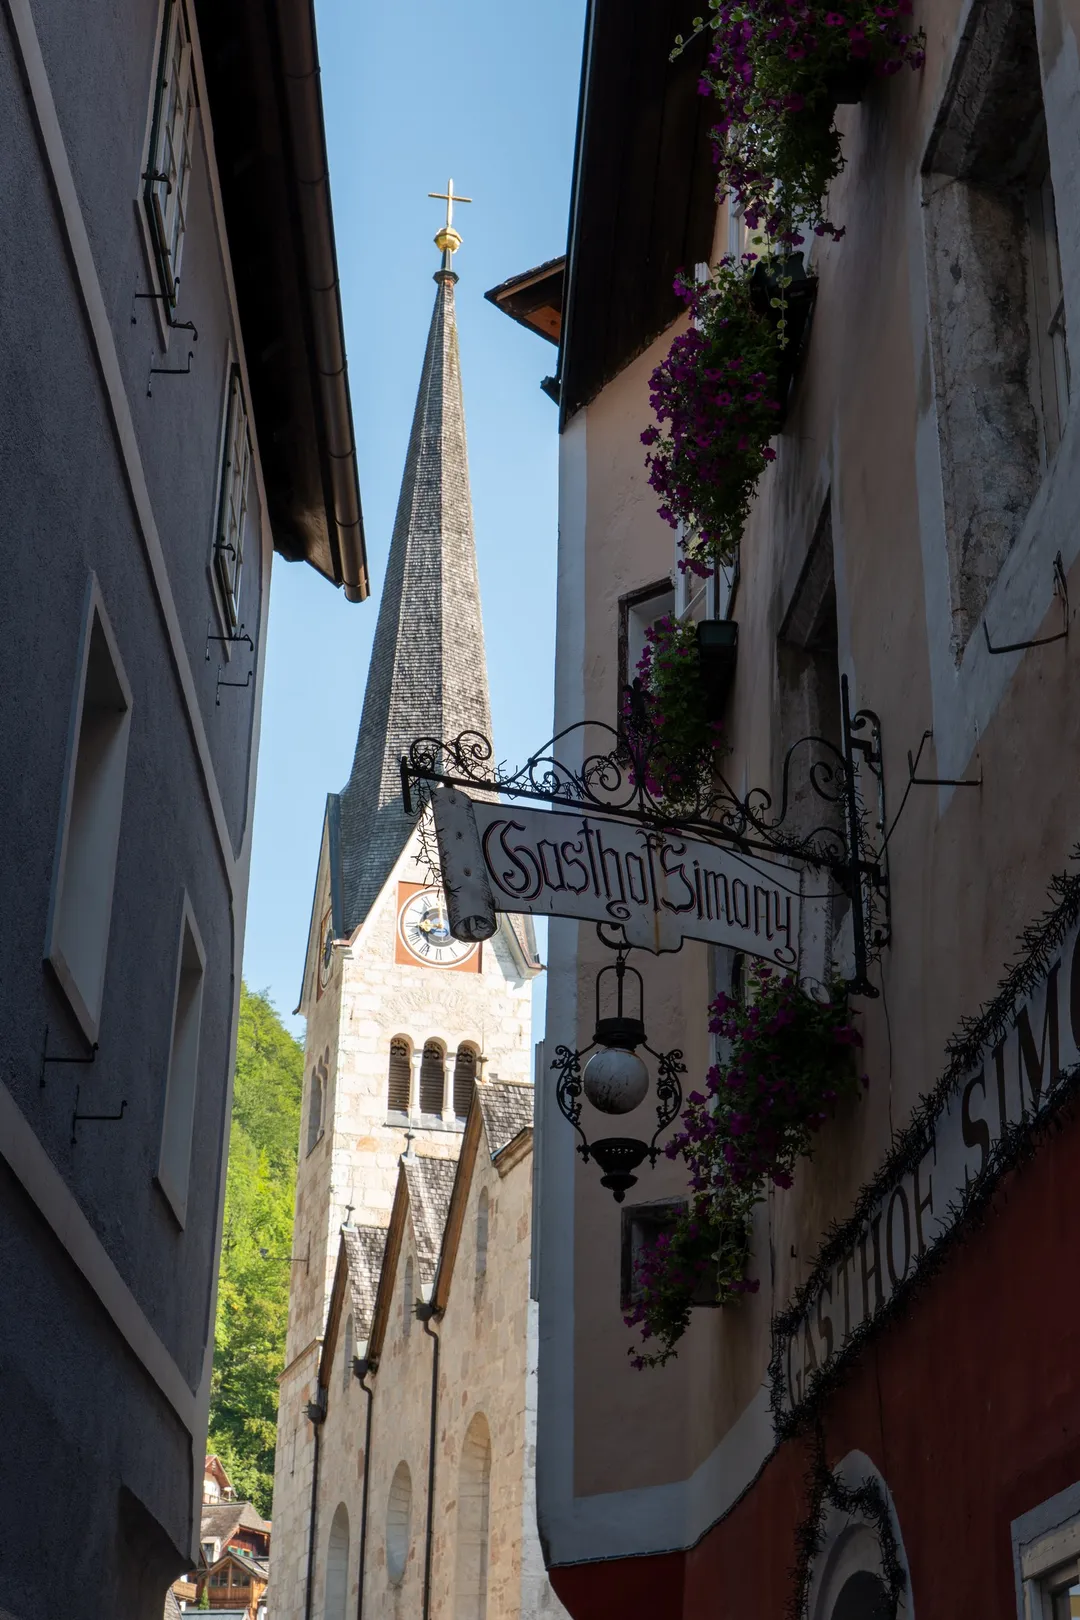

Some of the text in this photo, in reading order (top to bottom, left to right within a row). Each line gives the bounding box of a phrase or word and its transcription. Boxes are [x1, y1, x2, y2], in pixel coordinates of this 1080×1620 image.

[481, 818, 797, 965] Gasthof Simony
[787, 922, 1080, 1411] GASTHOF SIM
